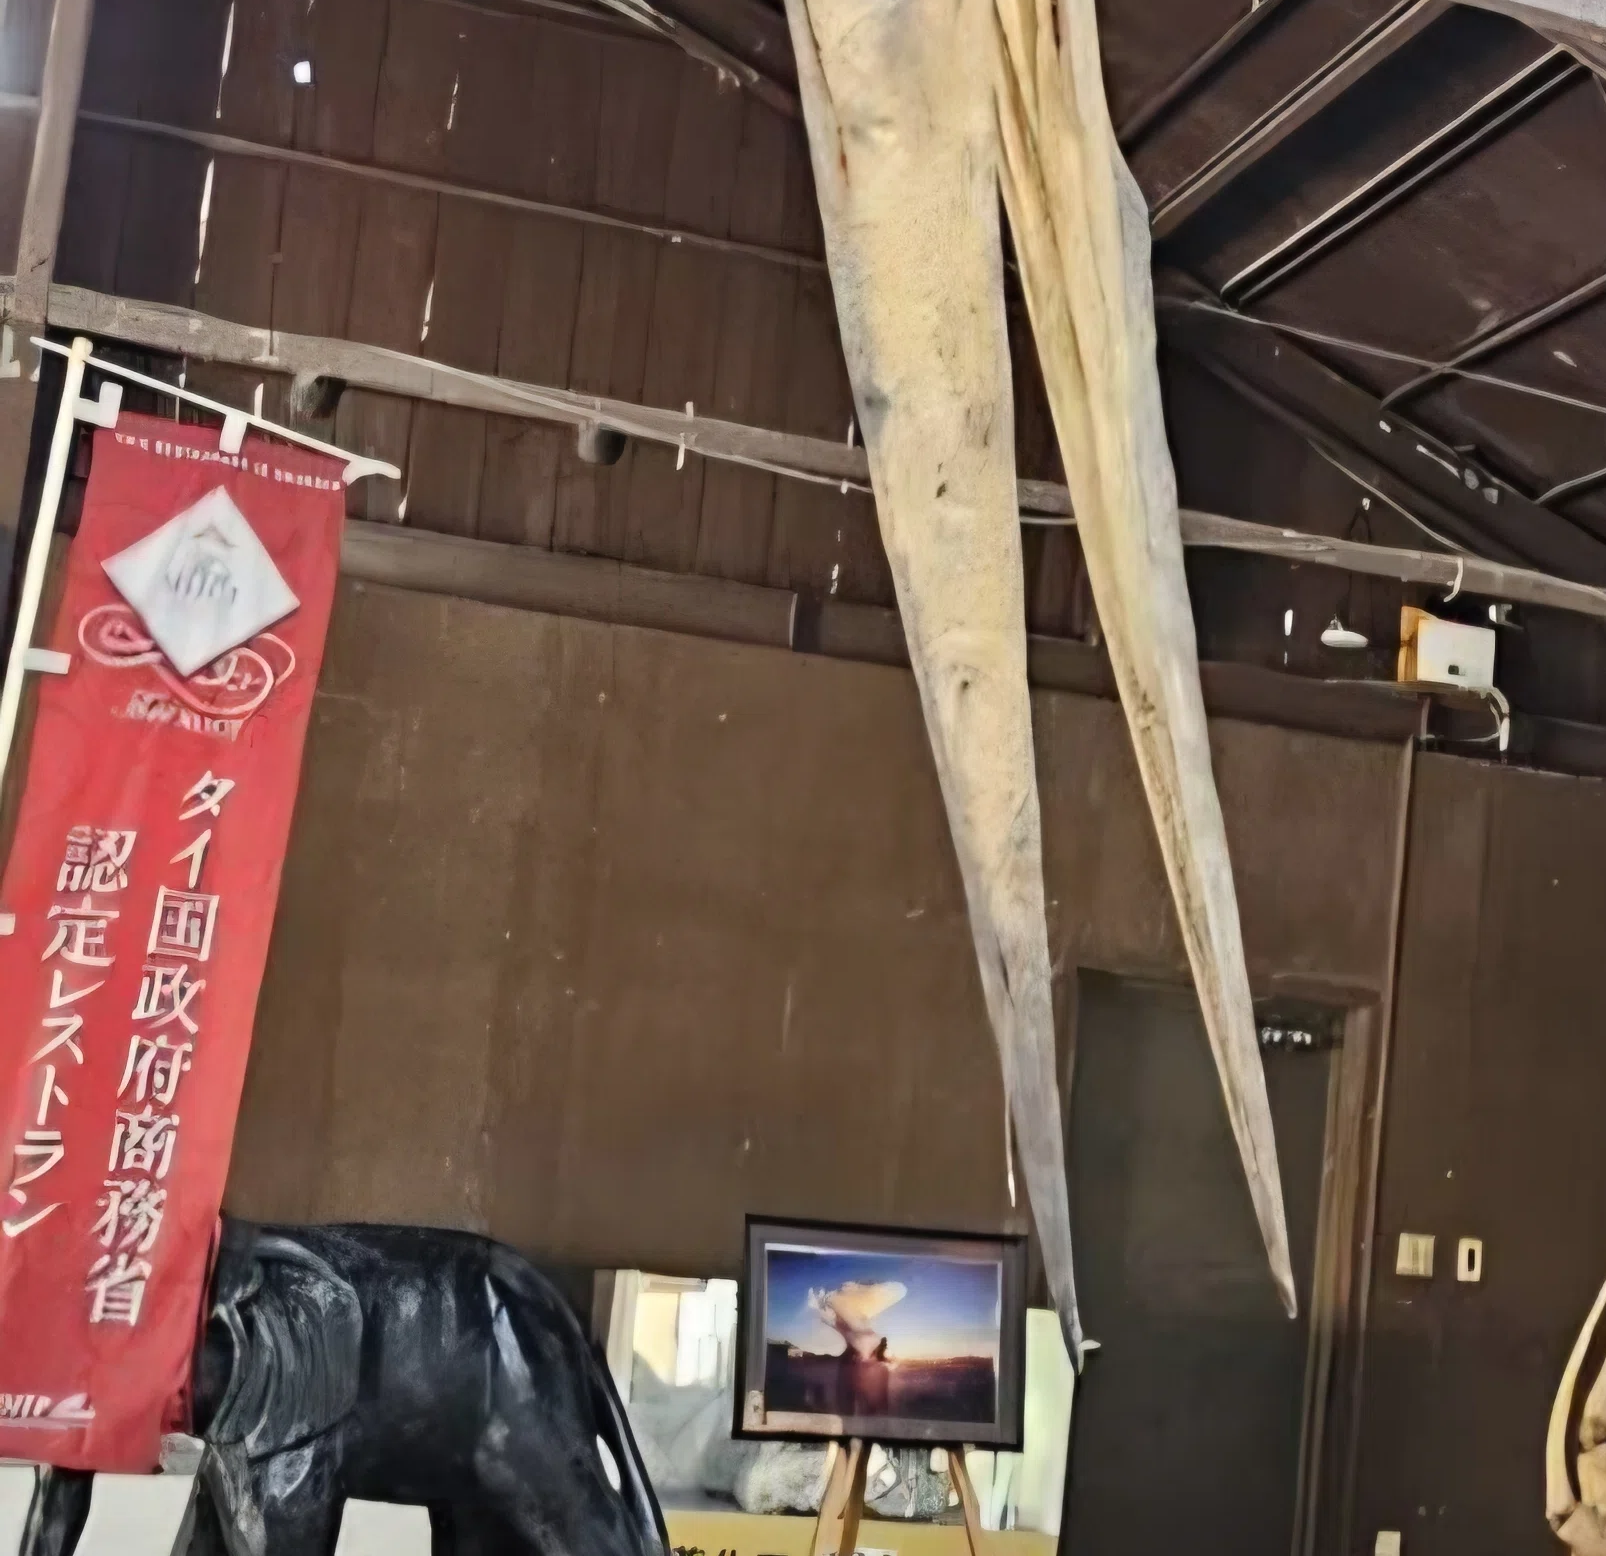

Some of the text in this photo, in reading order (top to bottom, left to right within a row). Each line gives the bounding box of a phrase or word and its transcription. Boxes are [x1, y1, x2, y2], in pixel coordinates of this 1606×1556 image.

[2, 825, 137, 1237] 認定レストラン
[84, 770, 236, 1327] タイ国政府商務省
